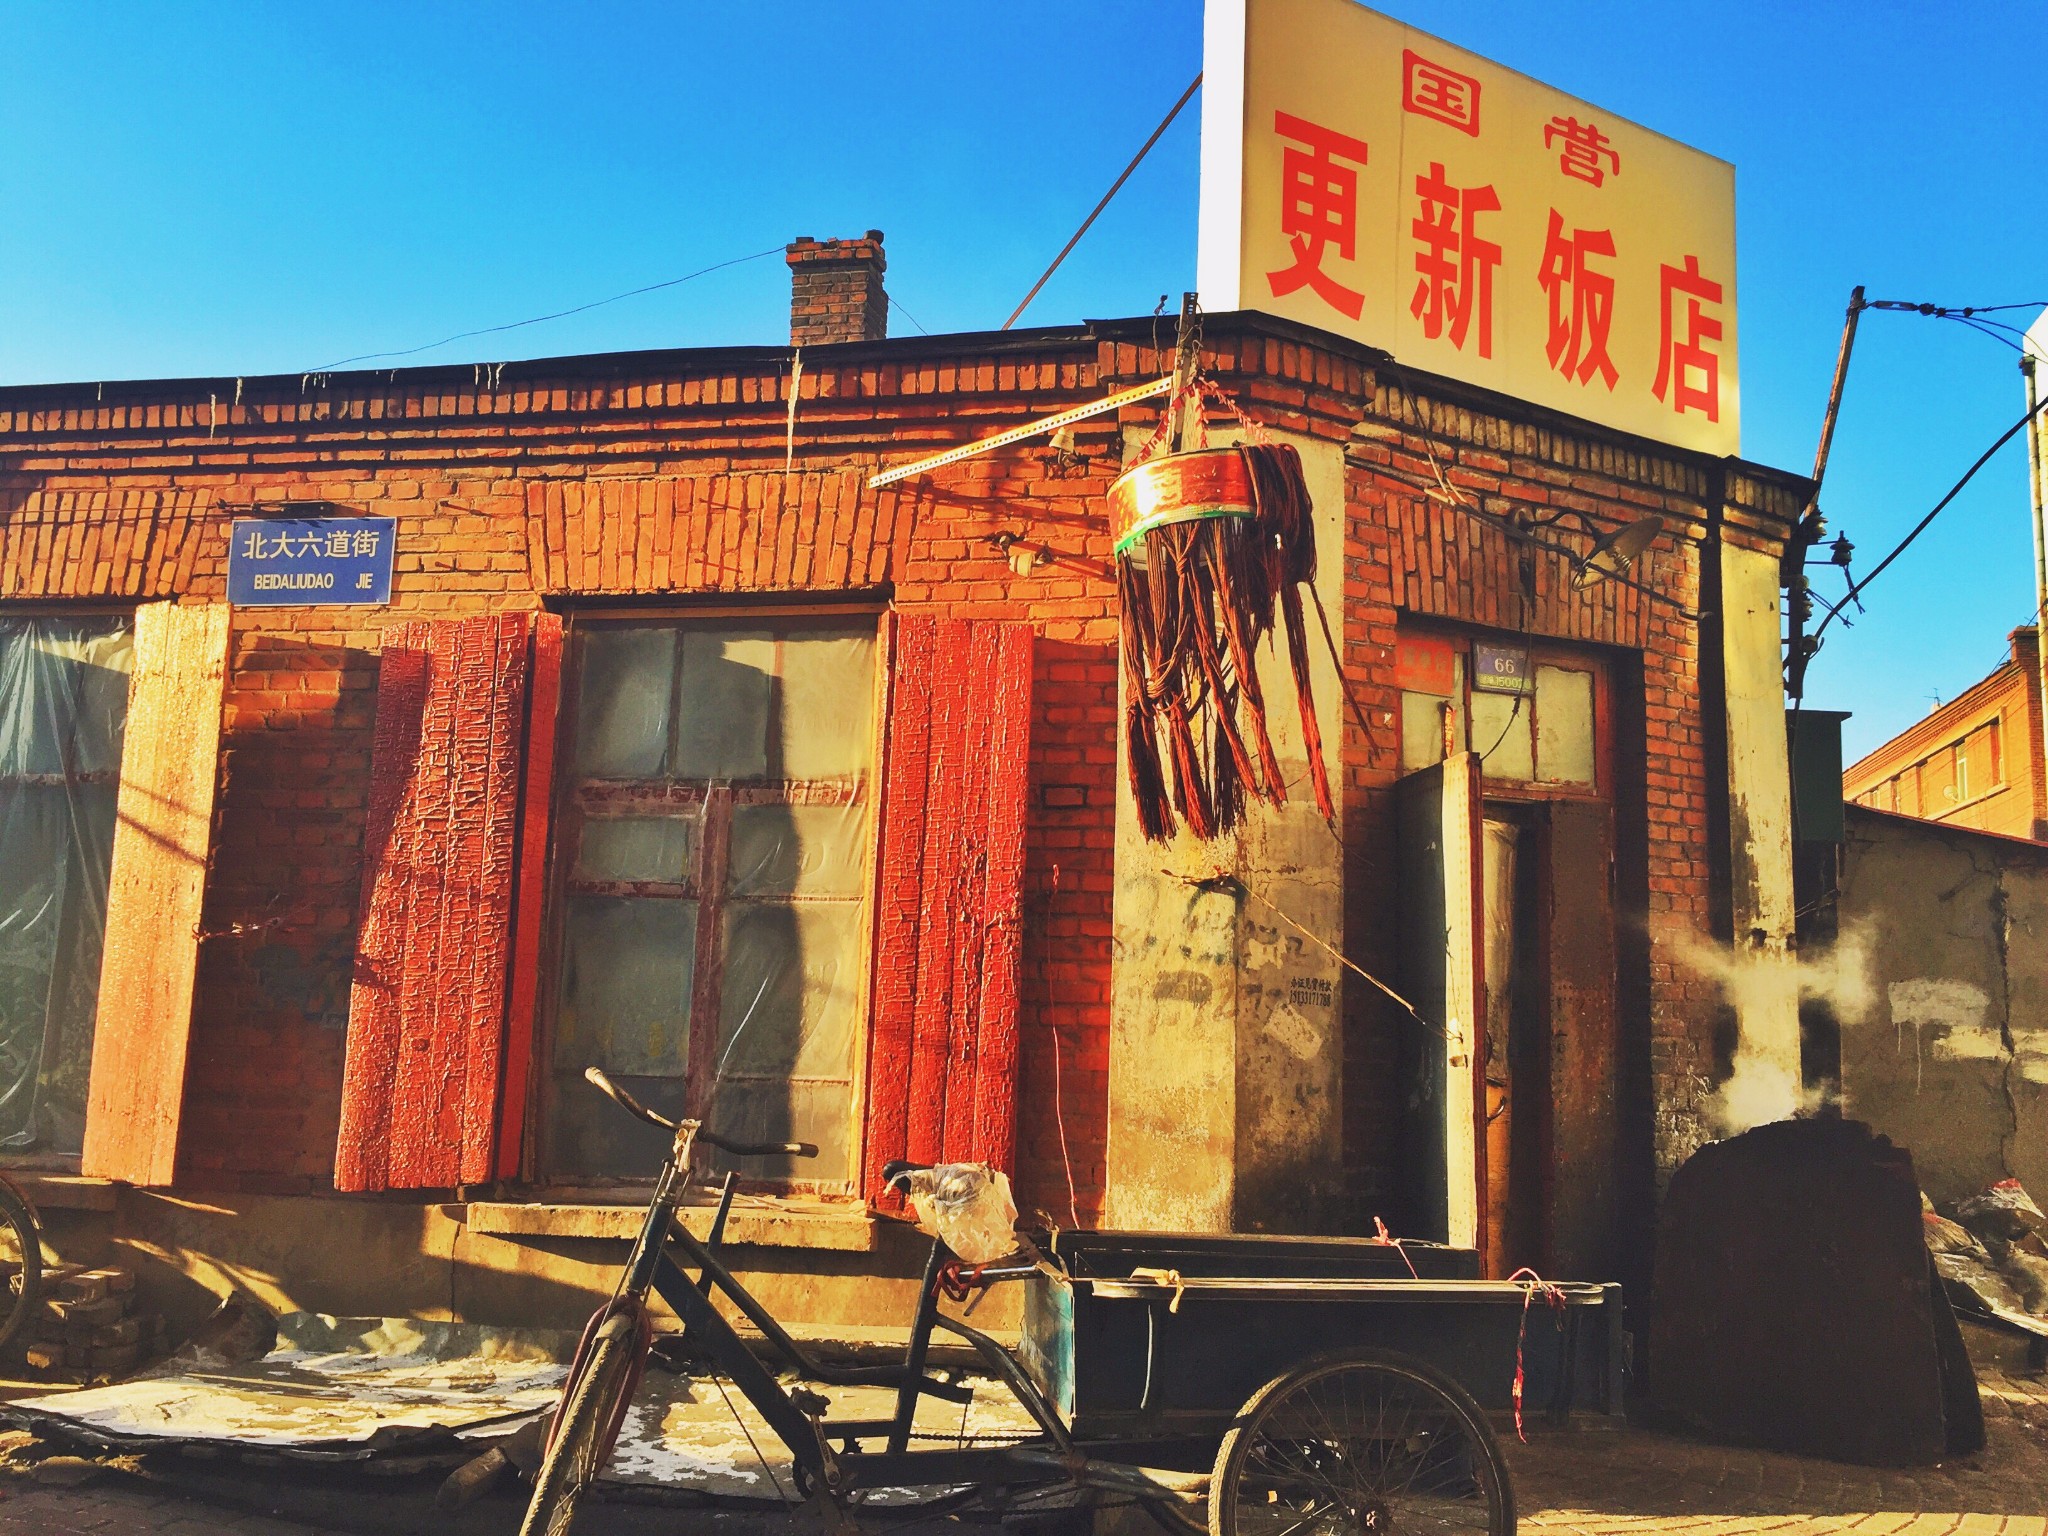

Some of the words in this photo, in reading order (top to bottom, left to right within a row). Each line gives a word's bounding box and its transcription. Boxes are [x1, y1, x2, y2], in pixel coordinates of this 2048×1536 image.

[1402, 48, 1620, 188] 国营
[1265, 109, 1723, 424] 更新饭店
[241, 529, 379, 559] 北大六道街
[254, 572, 334, 590] BEIDALIUDAO
[355, 572, 374, 589] JIE
[1494, 658, 1515, 674] 66
